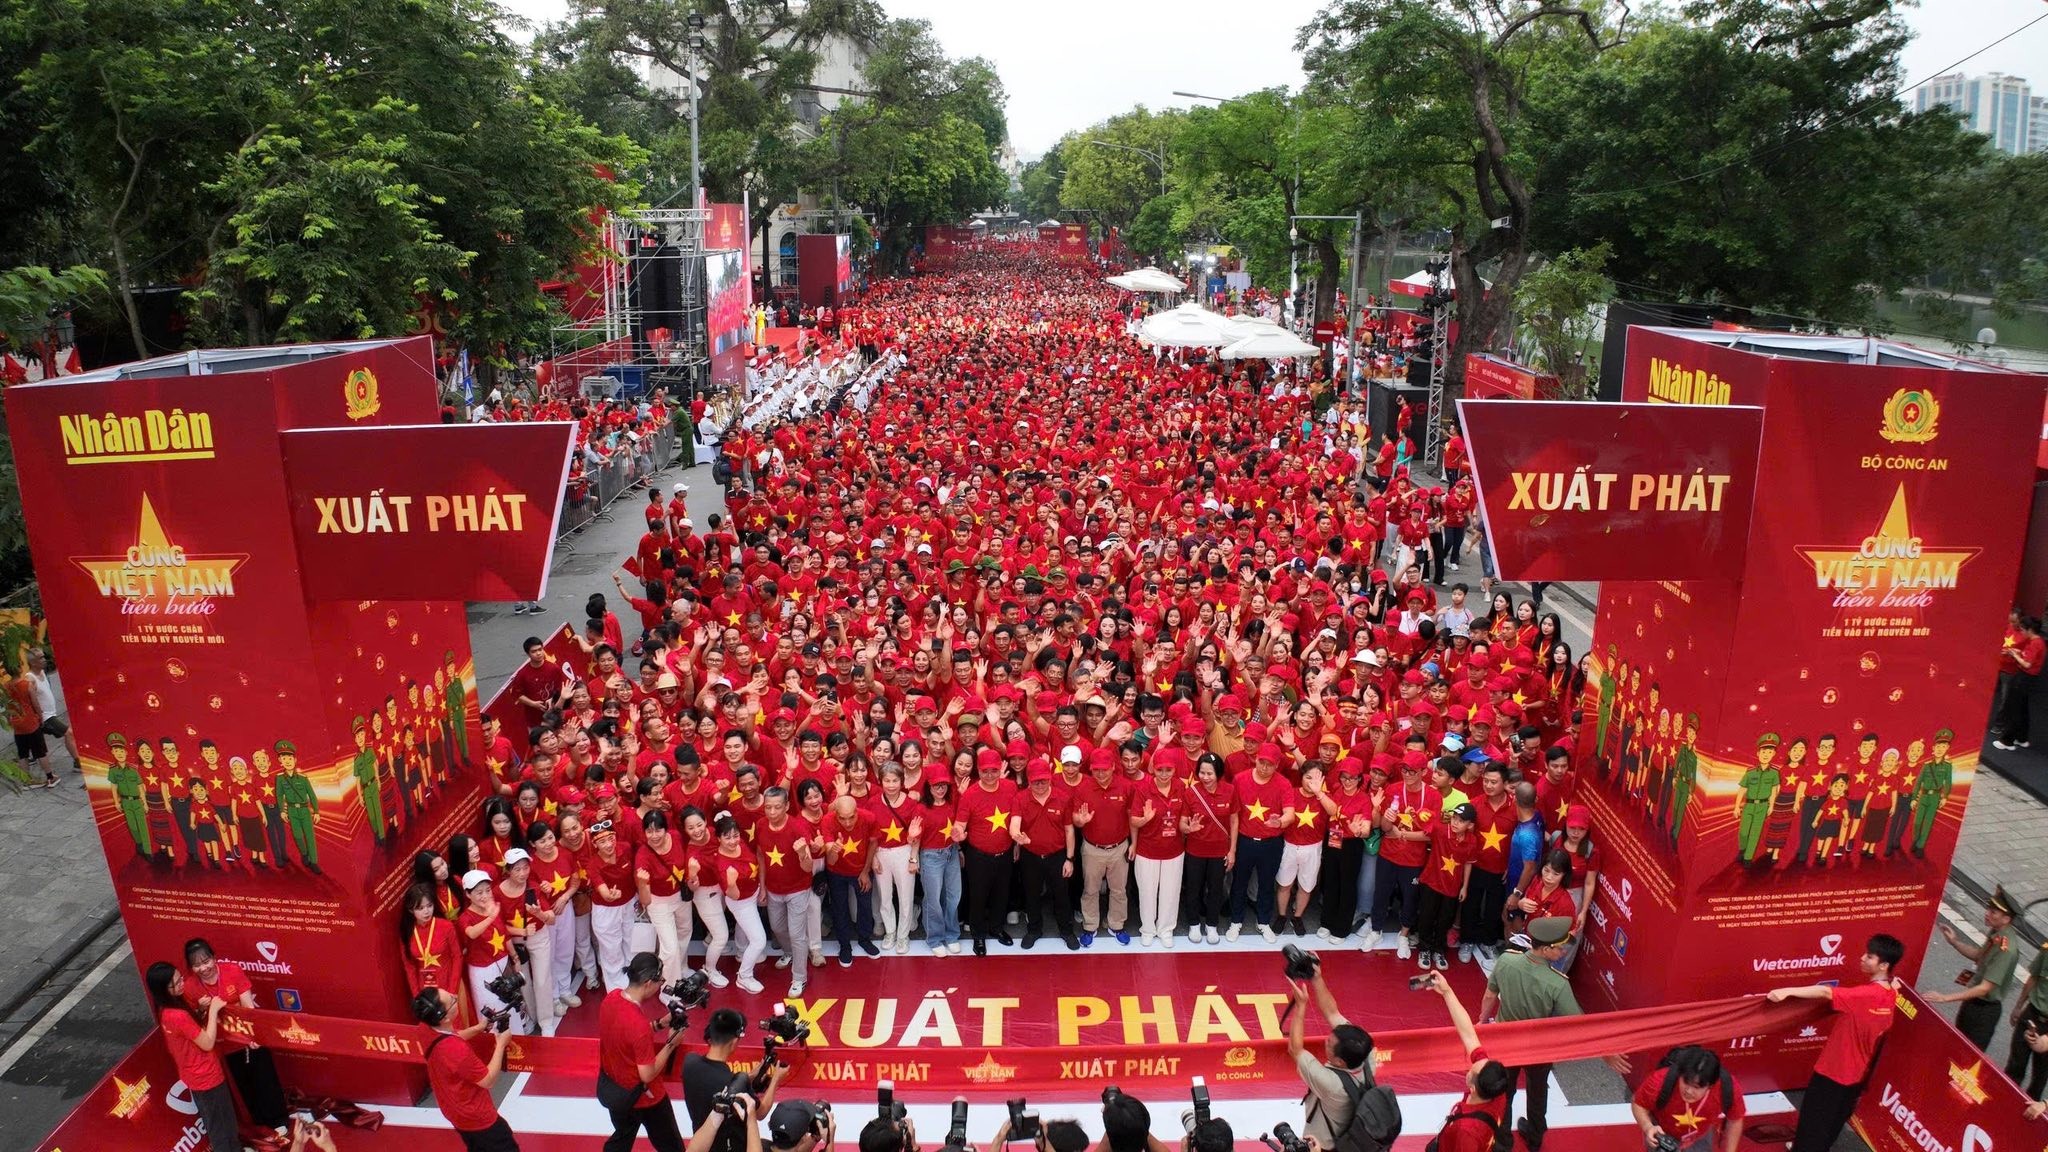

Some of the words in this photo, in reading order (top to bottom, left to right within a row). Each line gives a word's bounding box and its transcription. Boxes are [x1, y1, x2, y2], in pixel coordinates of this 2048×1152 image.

[1648, 357, 1693, 404] Nhân
[1693, 369, 1731, 405] Dân
[59, 412, 145, 455] Nhân
[145, 408, 213, 451] Dân
[1861, 454, 1881, 471] BỘ
[1885, 455, 1925, 469] CÔNG
[1927, 459, 1947, 470] AN
[1508, 465, 1618, 510] XUẤT
[1629, 468, 1731, 511] PHÁT
[314, 488, 412, 534] XUẤT
[426, 487, 526, 531] PHÁT
[127, 543, 186, 568] CÙNG
[1861, 533, 1922, 560] CÙNG
[94, 563, 157, 599] VIỆT
[162, 568, 235, 596] NAM
[1815, 556, 1886, 592] VIỆT
[1890, 560, 1961, 589] NAM
[121, 594, 160, 615] tiến
[165, 590, 216, 615] bước
[1832, 586, 1875, 608] tiến
[1879, 582, 1933, 608] bước
[1598, 872, 1632, 922] etcombank
[217, 958, 293, 974] ombank
[1753, 953, 1846, 971] Vietcombank
[783, 988, 1020, 1048] XUẤT
[1057, 986, 1289, 1046] PHÁT
[362, 1036, 411, 1054] XUẤT
[1375, 1051, 1392, 1062] AM
[813, 1060, 868, 1081] XUẤT
[876, 1060, 931, 1081] PHÁT
[991, 1068, 1014, 1078] NAM
[1060, 1057, 1117, 1079] XUẤT
[1125, 1056, 1181, 1076] PHÁT
[1216, 1071, 1227, 1081] BỘ
[1229, 1071, 1250, 1080] CÔNG
[1879, 1083, 1952, 1152] Vietcom
